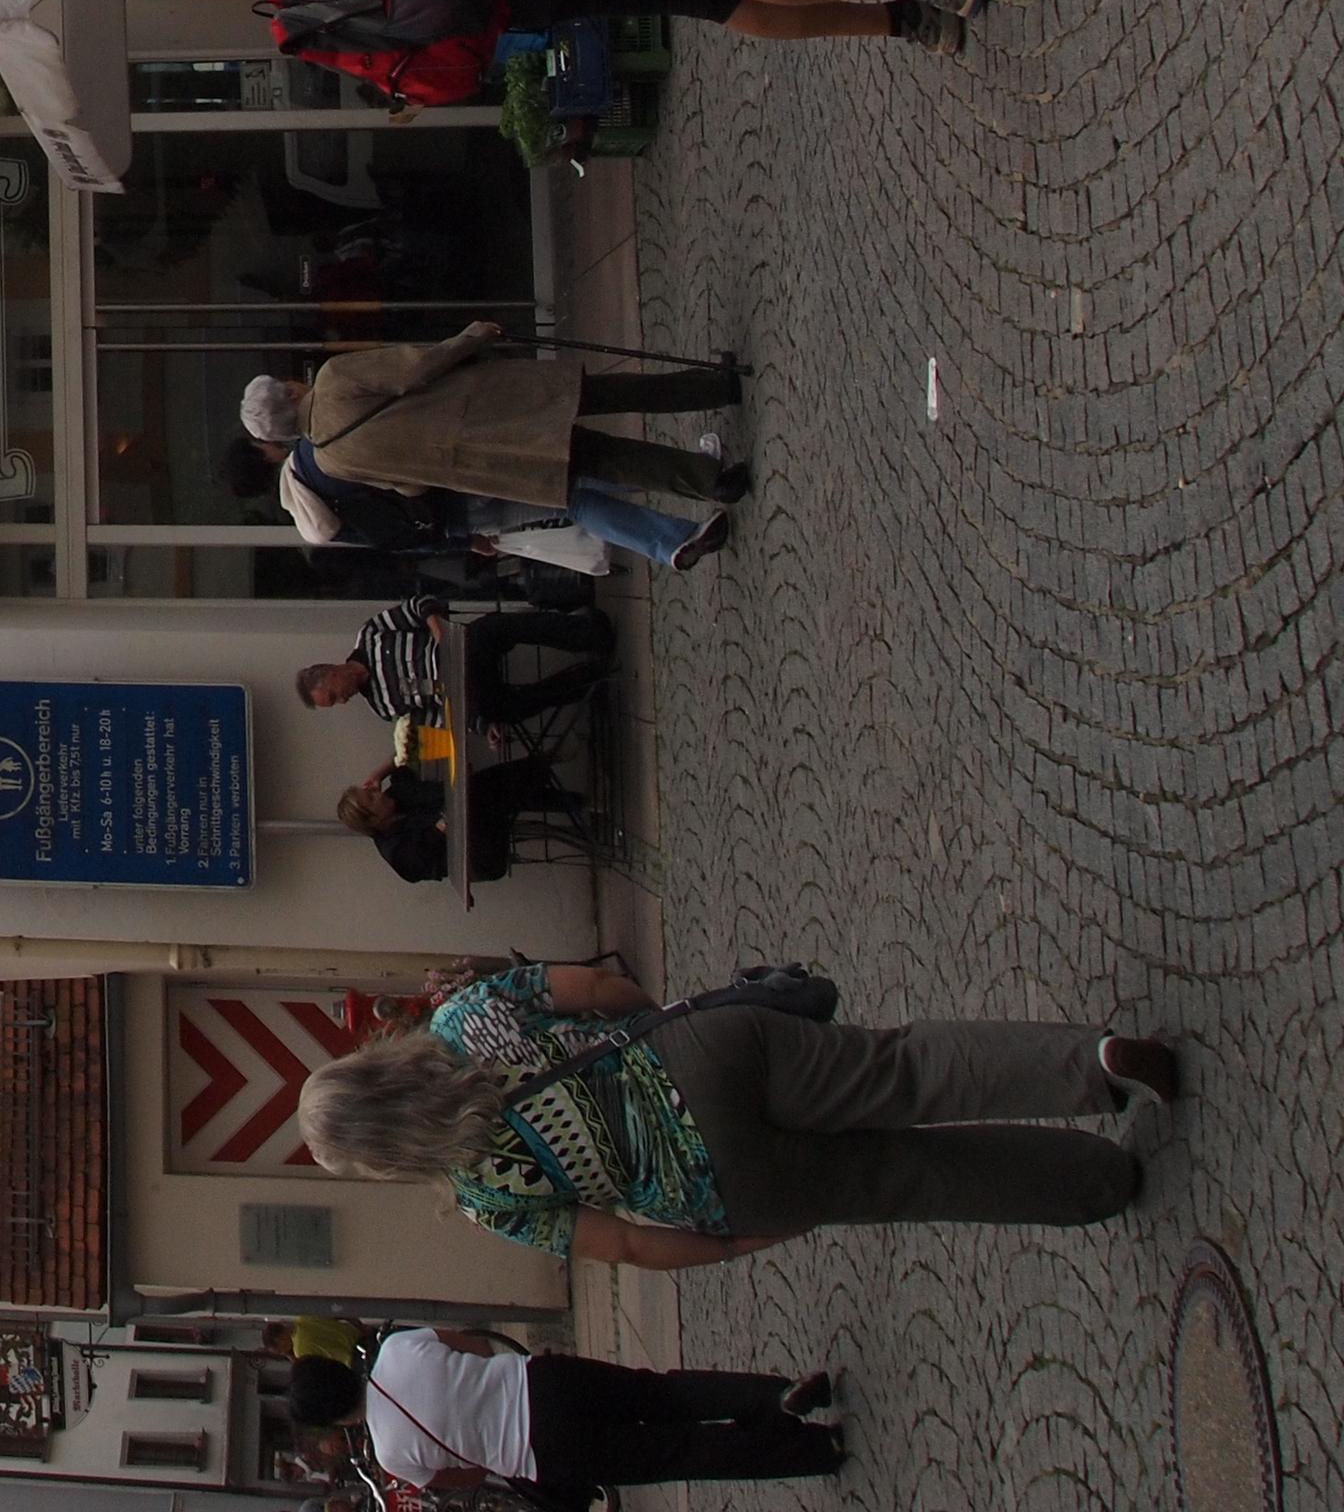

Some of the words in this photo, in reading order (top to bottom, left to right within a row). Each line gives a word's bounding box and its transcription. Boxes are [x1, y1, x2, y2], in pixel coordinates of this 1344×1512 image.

[71, 723, 80, 743] nur
[144, 711, 157, 770] gestattet:
[164, 718, 175, 737] hat
[35, 699, 54, 862] Fußgängerbereich
[71, 769, 81, 786] bis
[103, 756, 112, 766] u.
[198, 776, 207, 788] in
[229, 755, 240, 809] verboten
[58, 743, 69, 822] Lieferverkehr
[133, 759, 146, 819] folgenden
[164, 743, 177, 854] Fußgängerverkehr
[198, 790, 208, 811] nur
[209, 719, 222, 856] Schrittgeschwindigkeit
[71, 820, 81, 839] mit
[102, 811, 113, 851] Mo-Sa
[145, 774, 158, 854] Bedingungen
[179, 808, 191, 854] Vorrang
[198, 814, 209, 856] Fahren
[229, 814, 240, 856] Parken
[134, 823, 143, 853] unter
[199, 857, 209, 868] 2.
